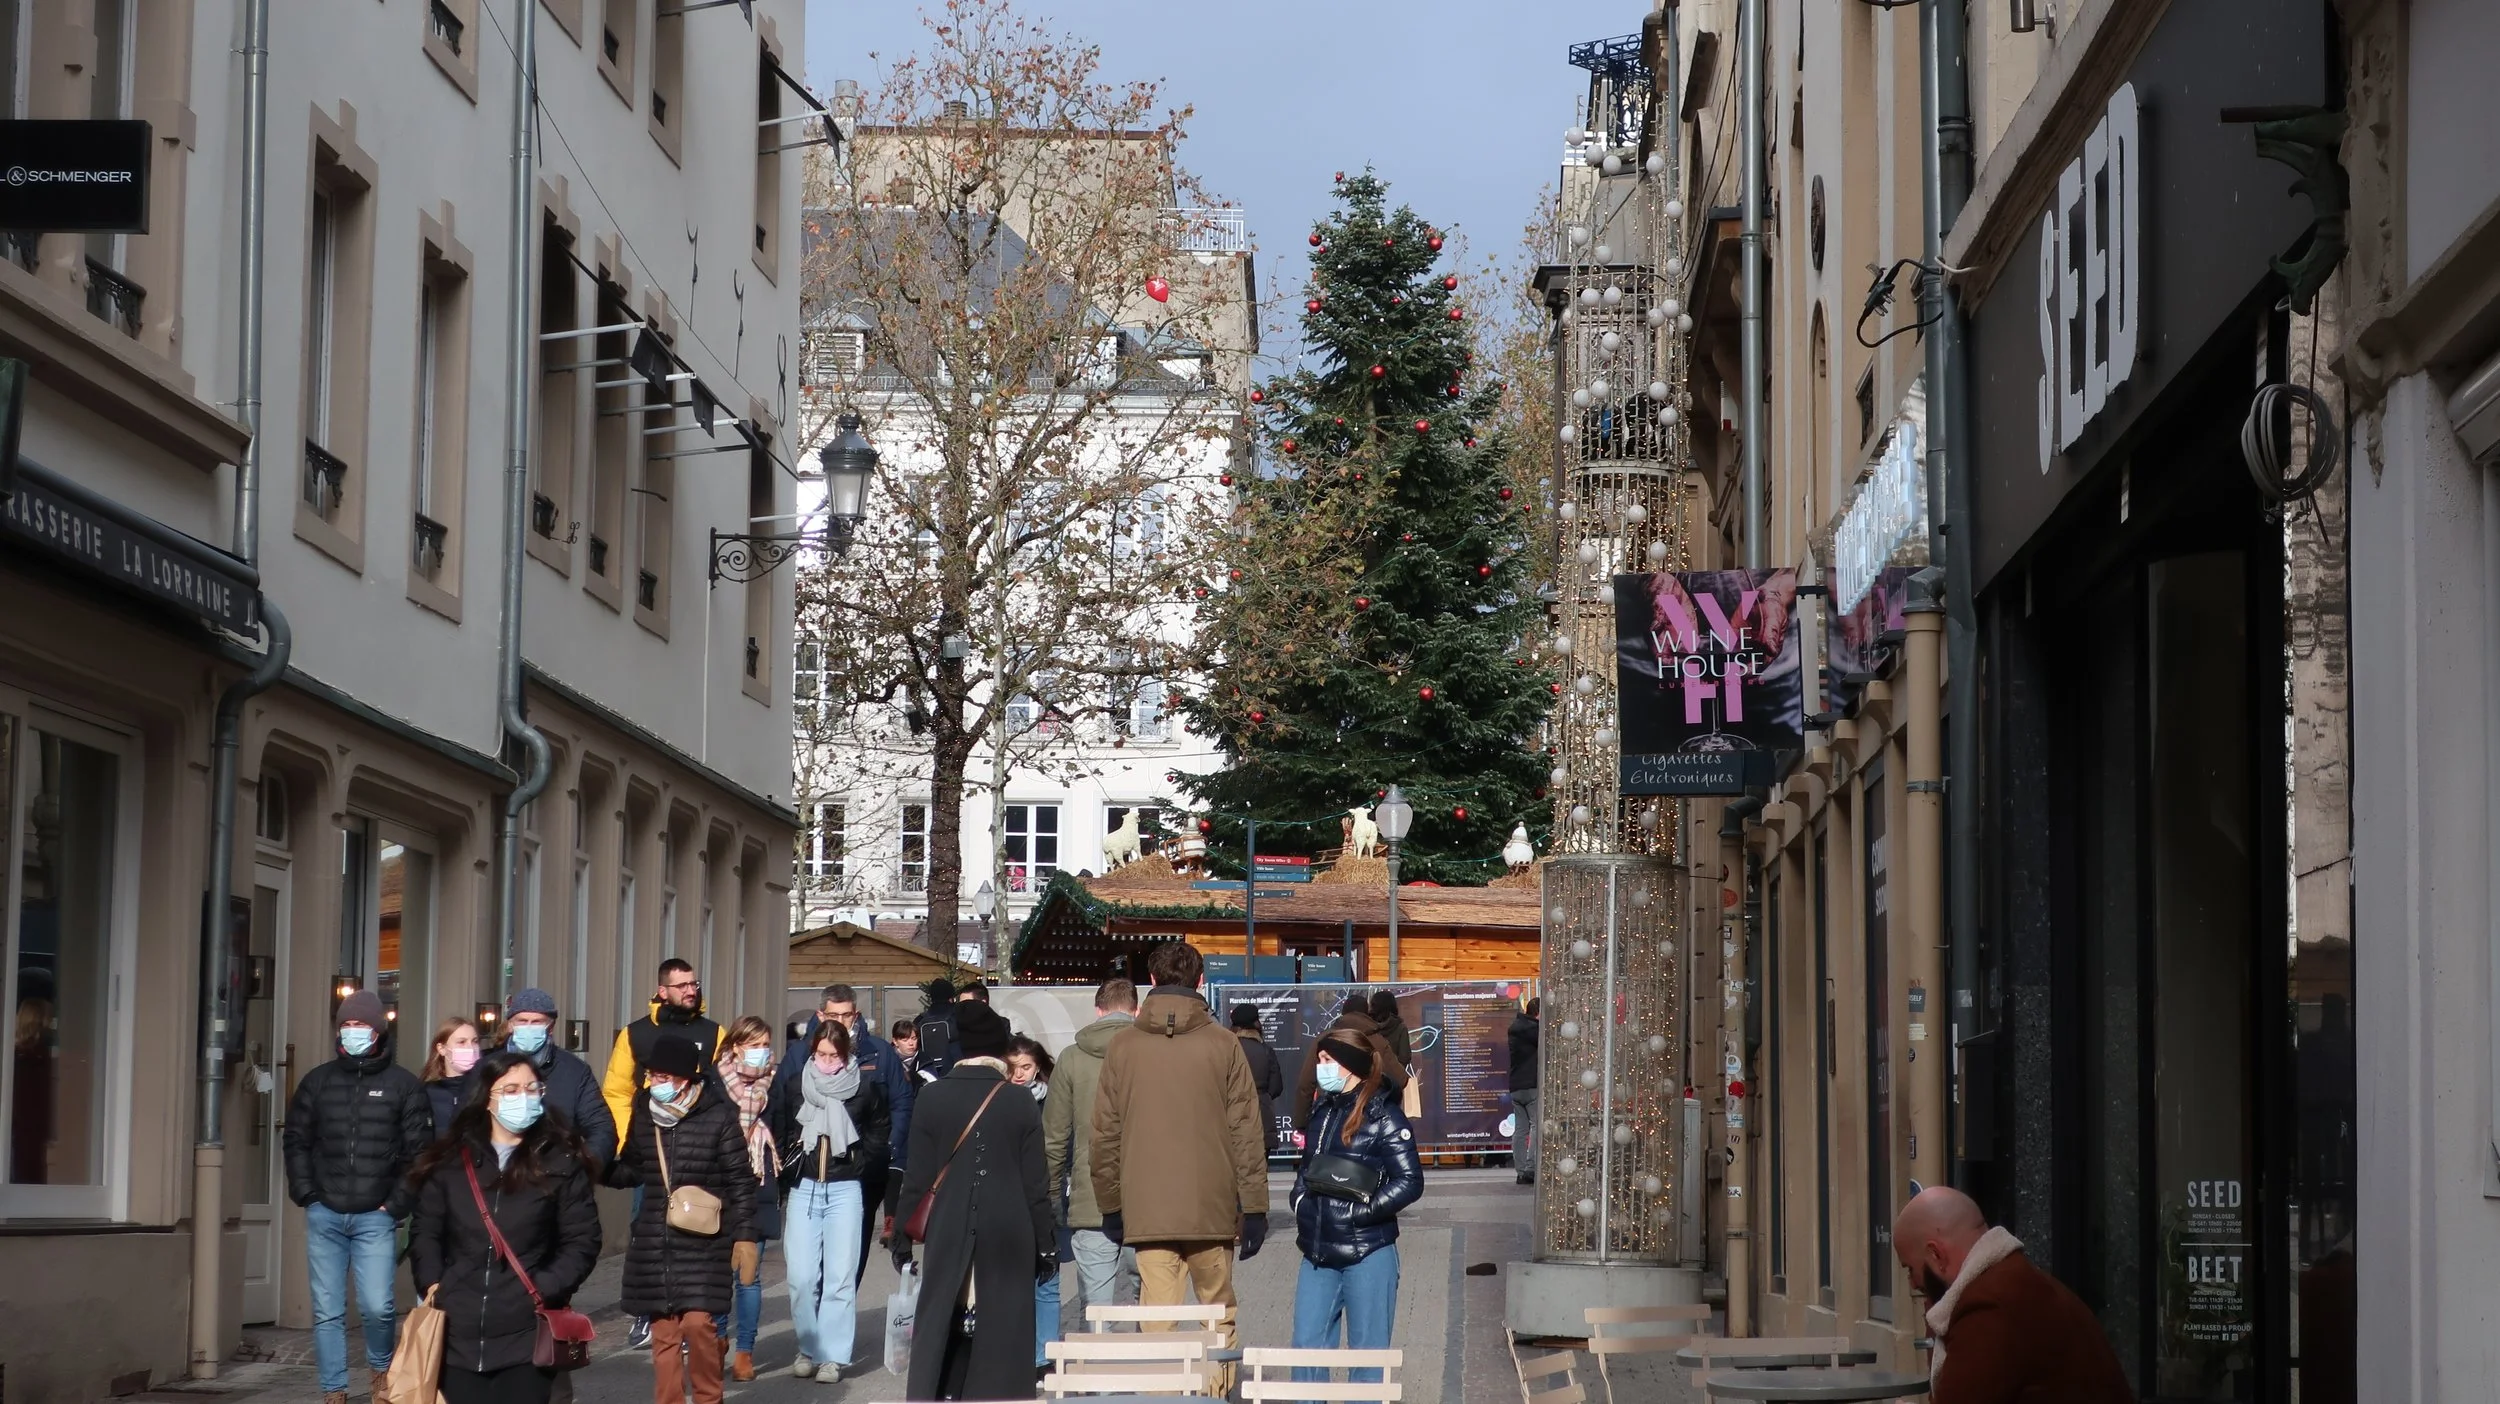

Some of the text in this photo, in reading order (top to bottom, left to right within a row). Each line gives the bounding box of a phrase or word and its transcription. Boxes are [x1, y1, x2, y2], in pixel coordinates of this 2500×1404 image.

[27, 170, 132, 182] SCHMENGER
[2039, 81, 2139, 475] SEED
[2, 491, 102, 560] RASSERIE
[122, 540, 143, 578] LA
[151, 553, 231, 617] LORRAINE
[1651, 627, 1753, 653] WINE
[1657, 652, 1765, 679] HOUSE
[1642, 753, 1722, 771] Cigarettes
[1630, 769, 1734, 787] Electroniques
[2187, 1181, 2242, 1208] SEED
[2188, 1256, 2242, 1283] BEET
[2183, 1323, 2201, 1331] PLANT
[2228, 1324, 2252, 1332] PROUD
